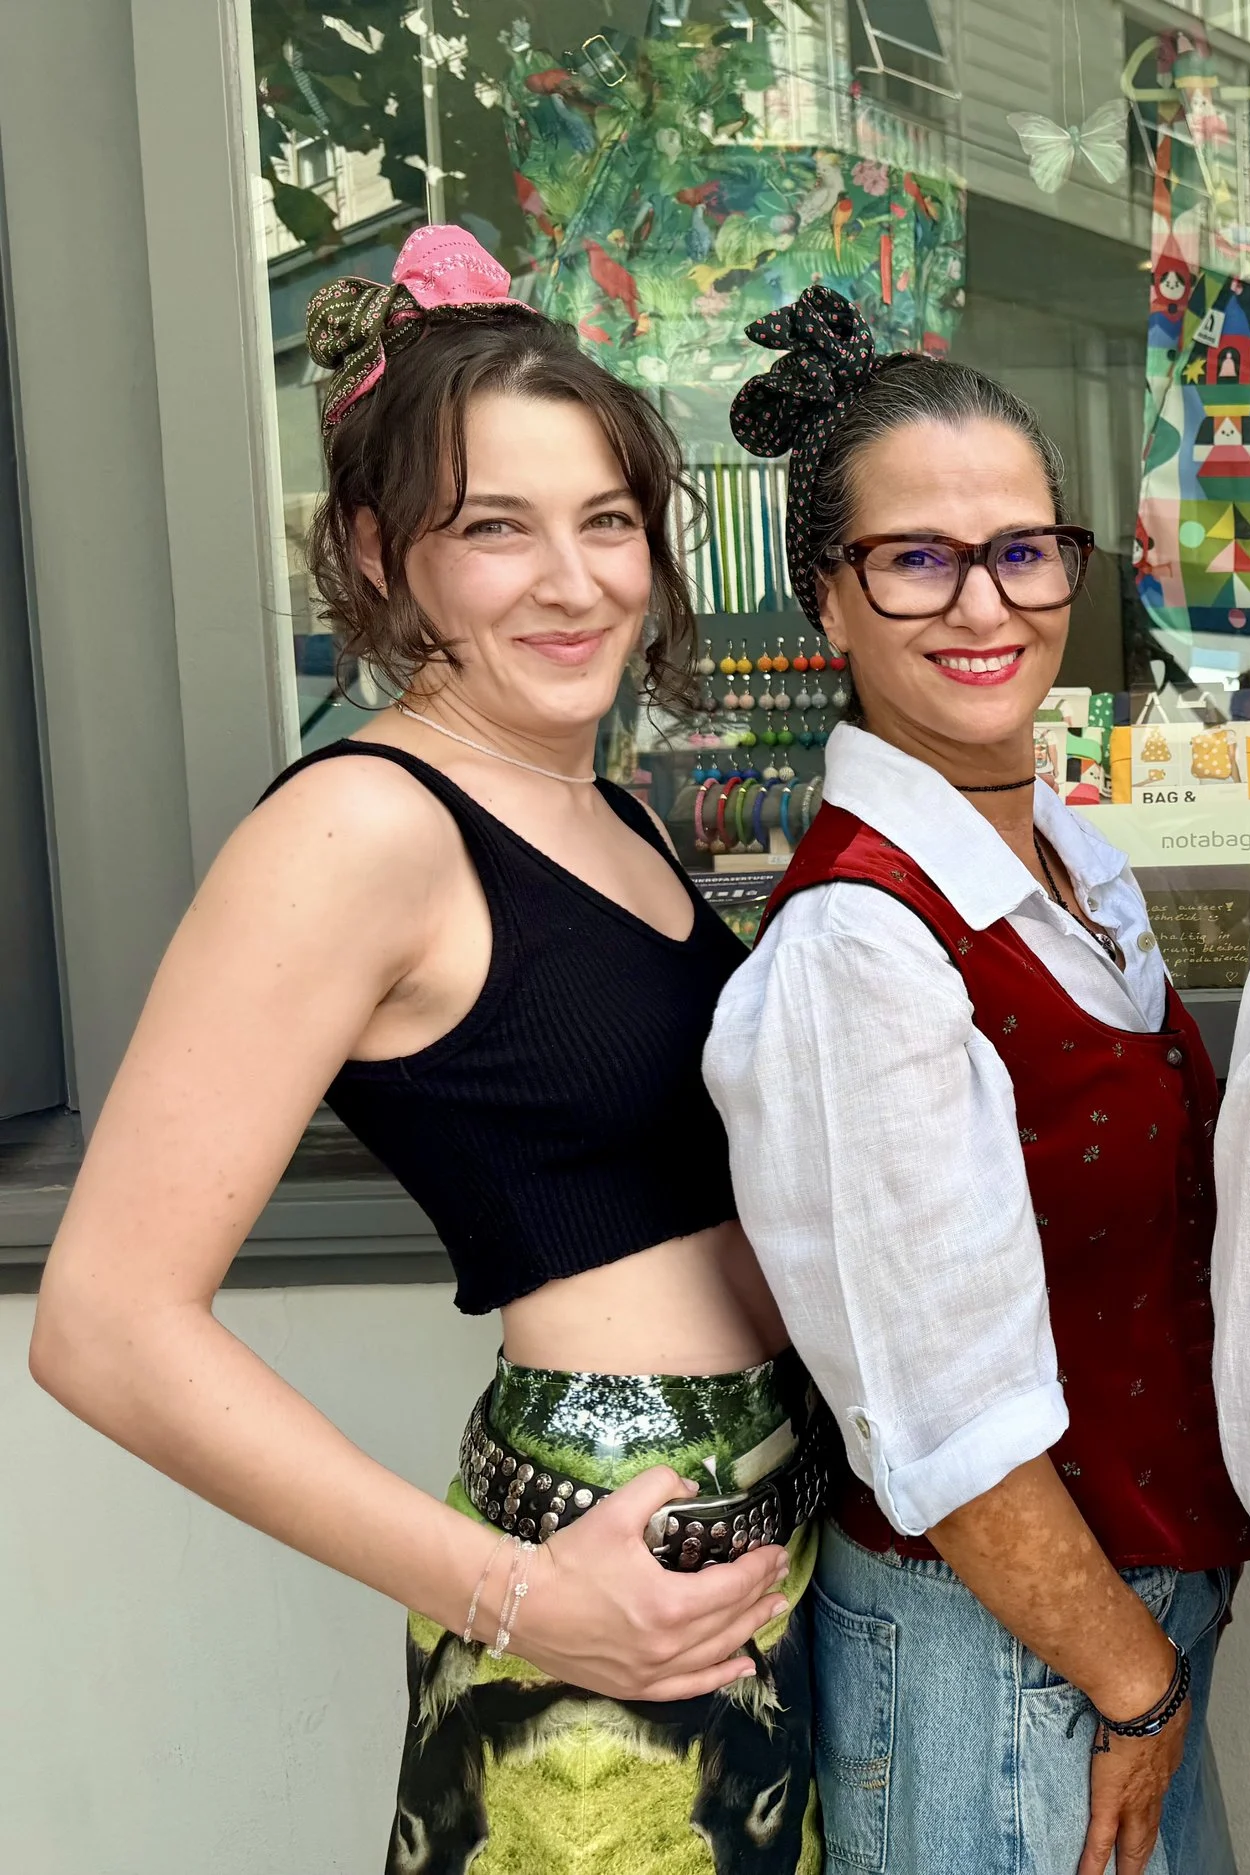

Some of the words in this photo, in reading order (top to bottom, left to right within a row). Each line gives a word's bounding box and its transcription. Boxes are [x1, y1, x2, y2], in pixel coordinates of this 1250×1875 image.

[1143, 791, 1179, 804] BAG
[1184, 790, 1196, 803] &
[691, 875, 774, 883] IKROFASERTUCH
